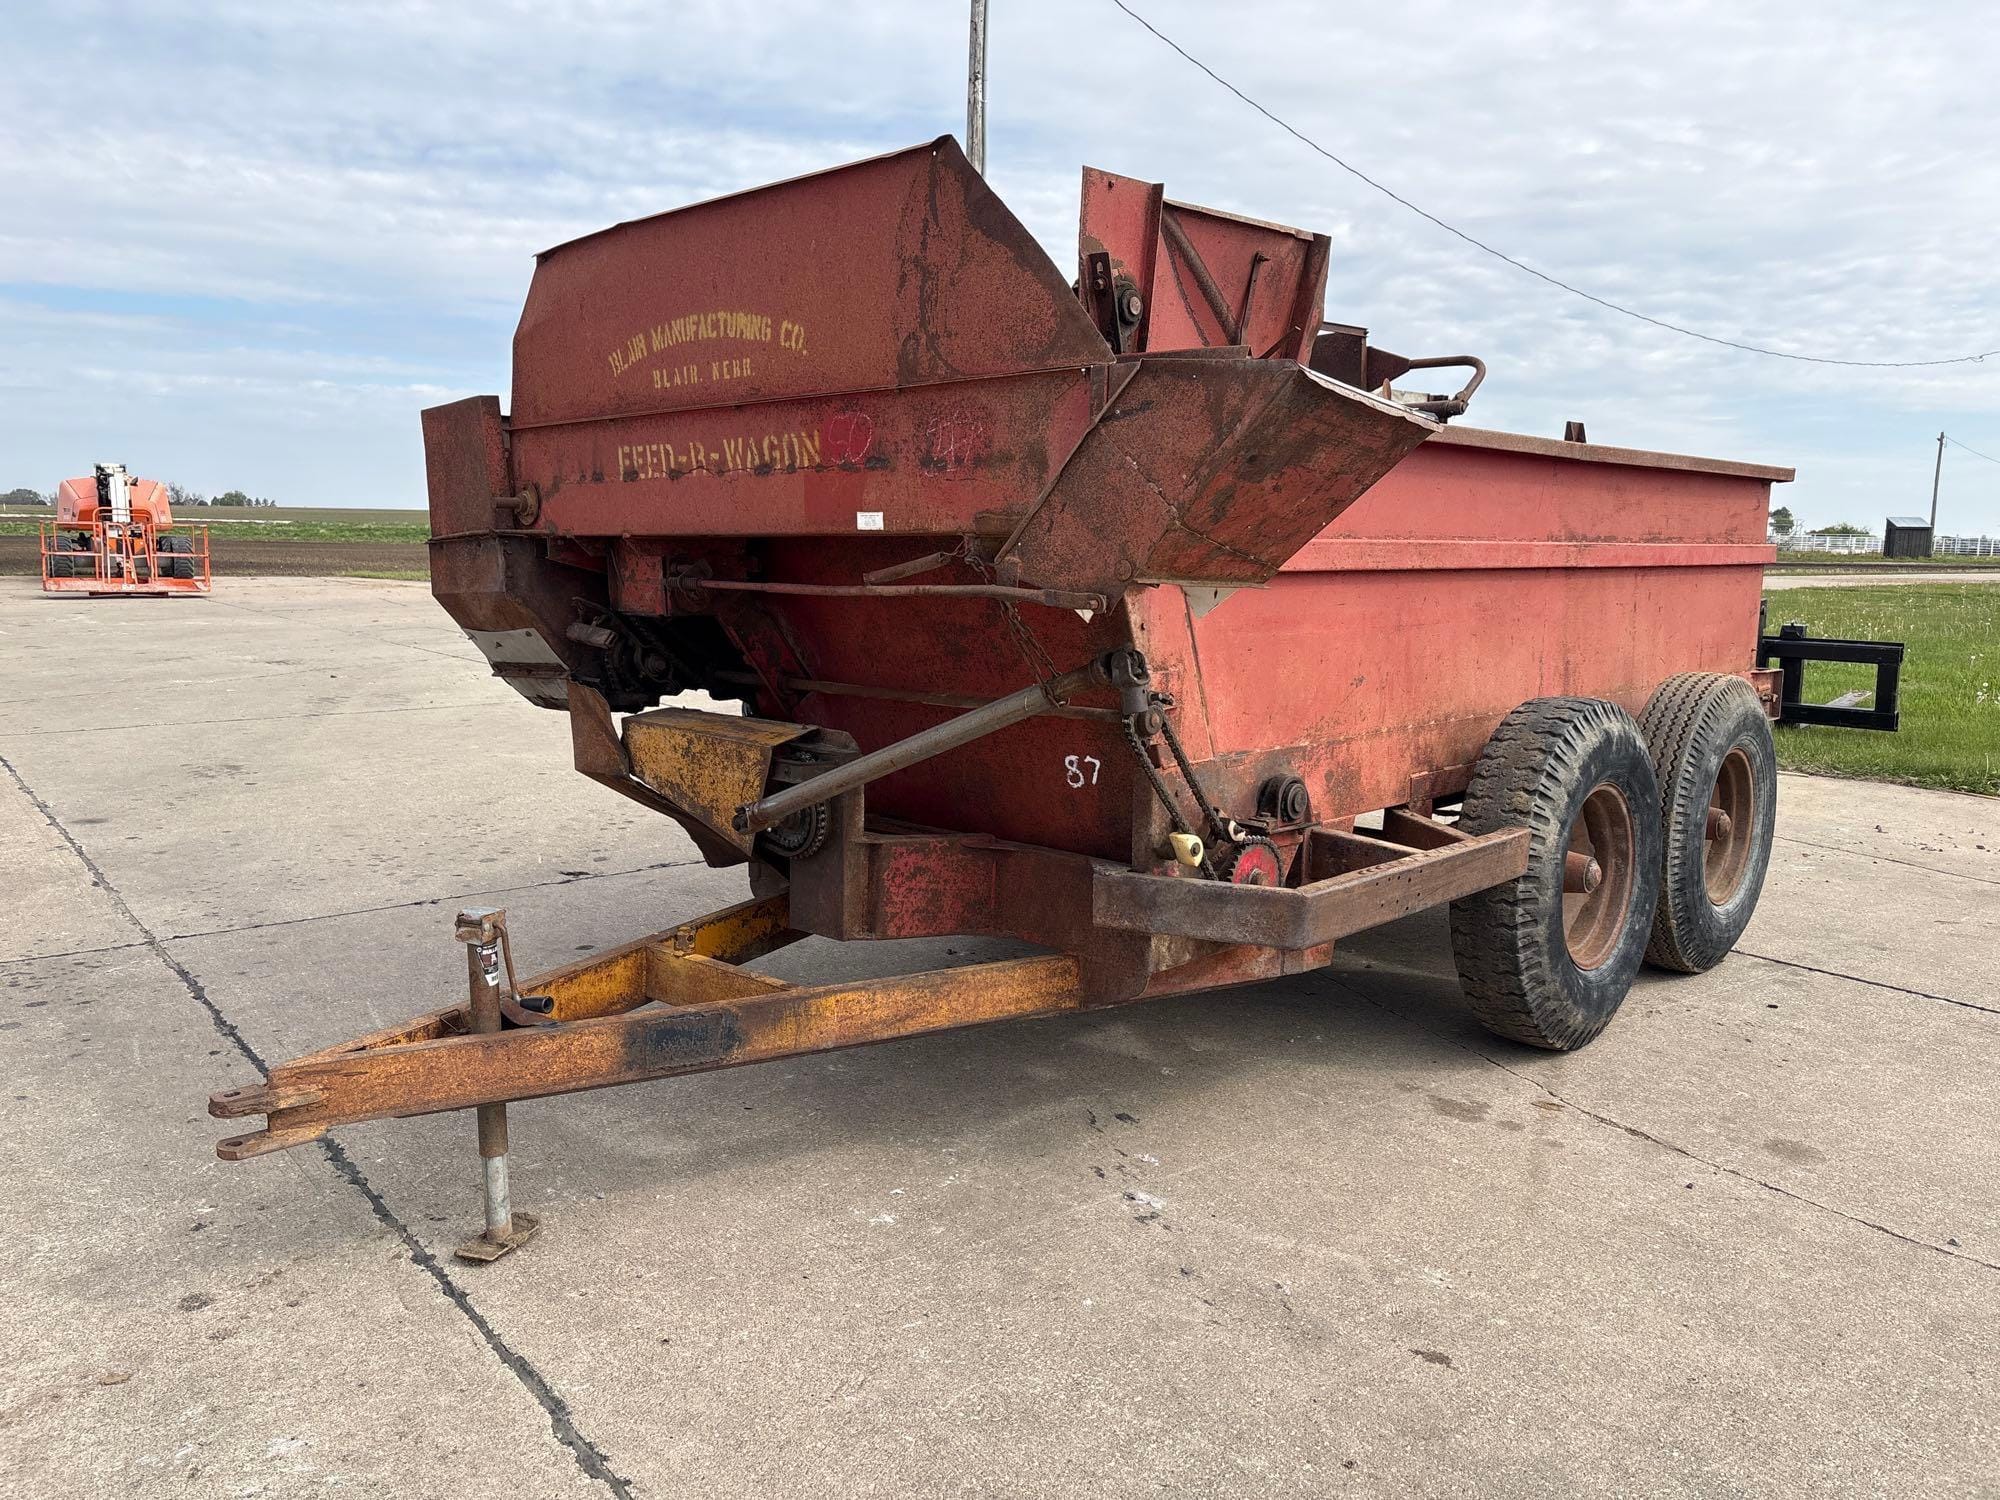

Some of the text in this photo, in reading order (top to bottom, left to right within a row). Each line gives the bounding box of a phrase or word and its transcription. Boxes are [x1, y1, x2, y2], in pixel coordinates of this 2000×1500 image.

[608, 311, 807, 377] BLAIR MANUFACTURING CO.
[1064, 754, 1101, 788] 87
